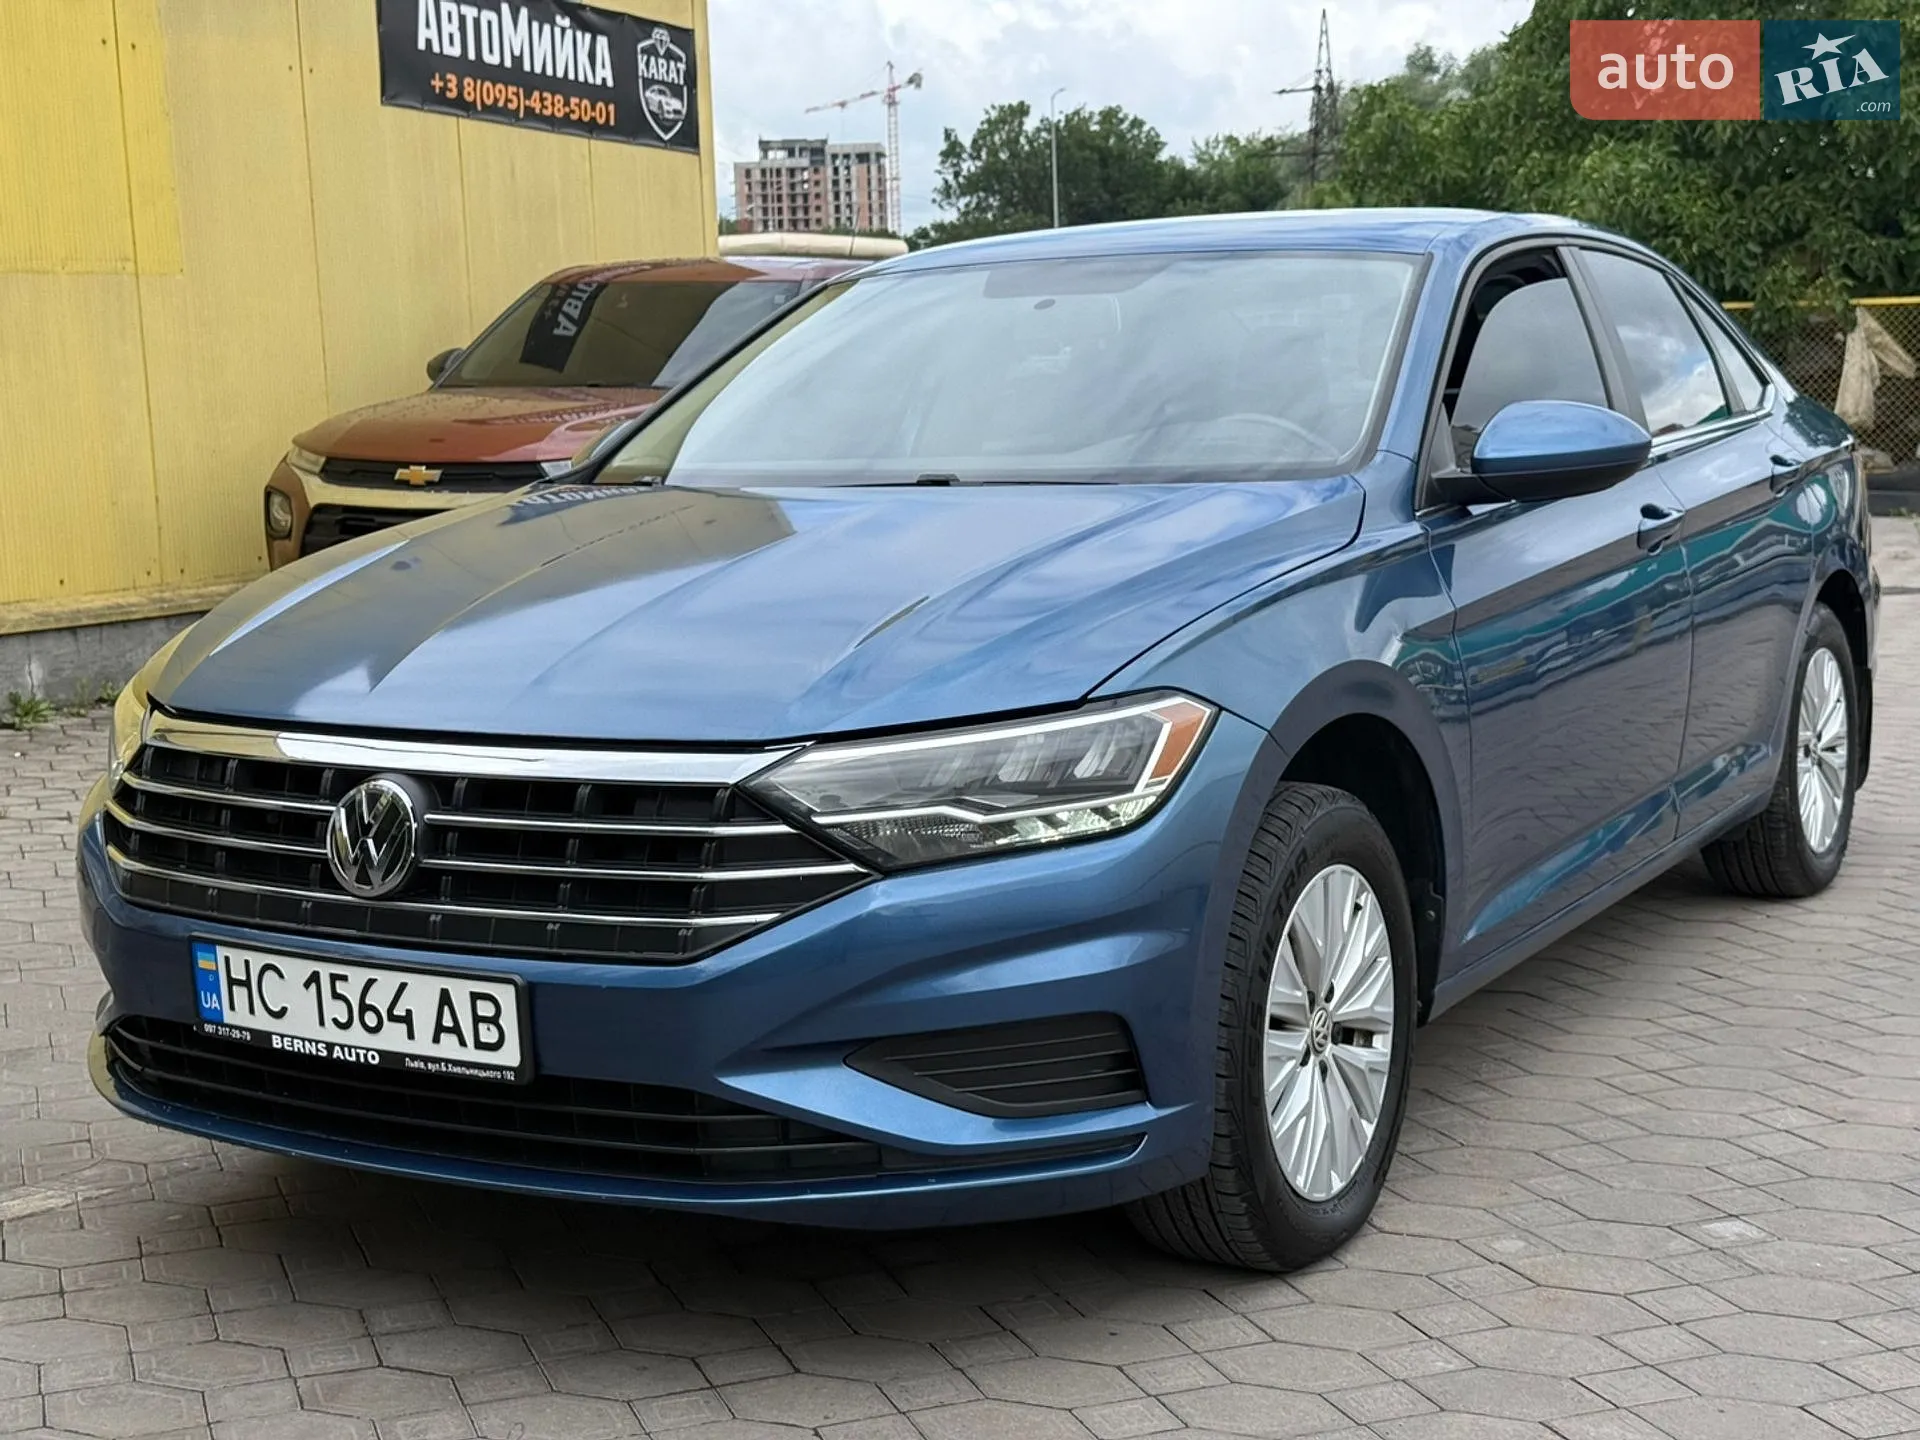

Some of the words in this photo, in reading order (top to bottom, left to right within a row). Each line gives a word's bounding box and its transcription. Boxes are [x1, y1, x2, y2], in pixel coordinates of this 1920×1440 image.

[637, 53, 687, 86] KARAT
[430, 72, 458, 99] +3
[463, 80, 616, 126] 8(095)-438-50-01
[201, 990, 221, 1011] UA
[224, 954, 289, 1020] HC
[302, 969, 416, 1041] 1564
[431, 987, 507, 1053] AB
[271, 1034, 329, 1058] BERNS
[332, 1044, 381, 1066] AUTO
